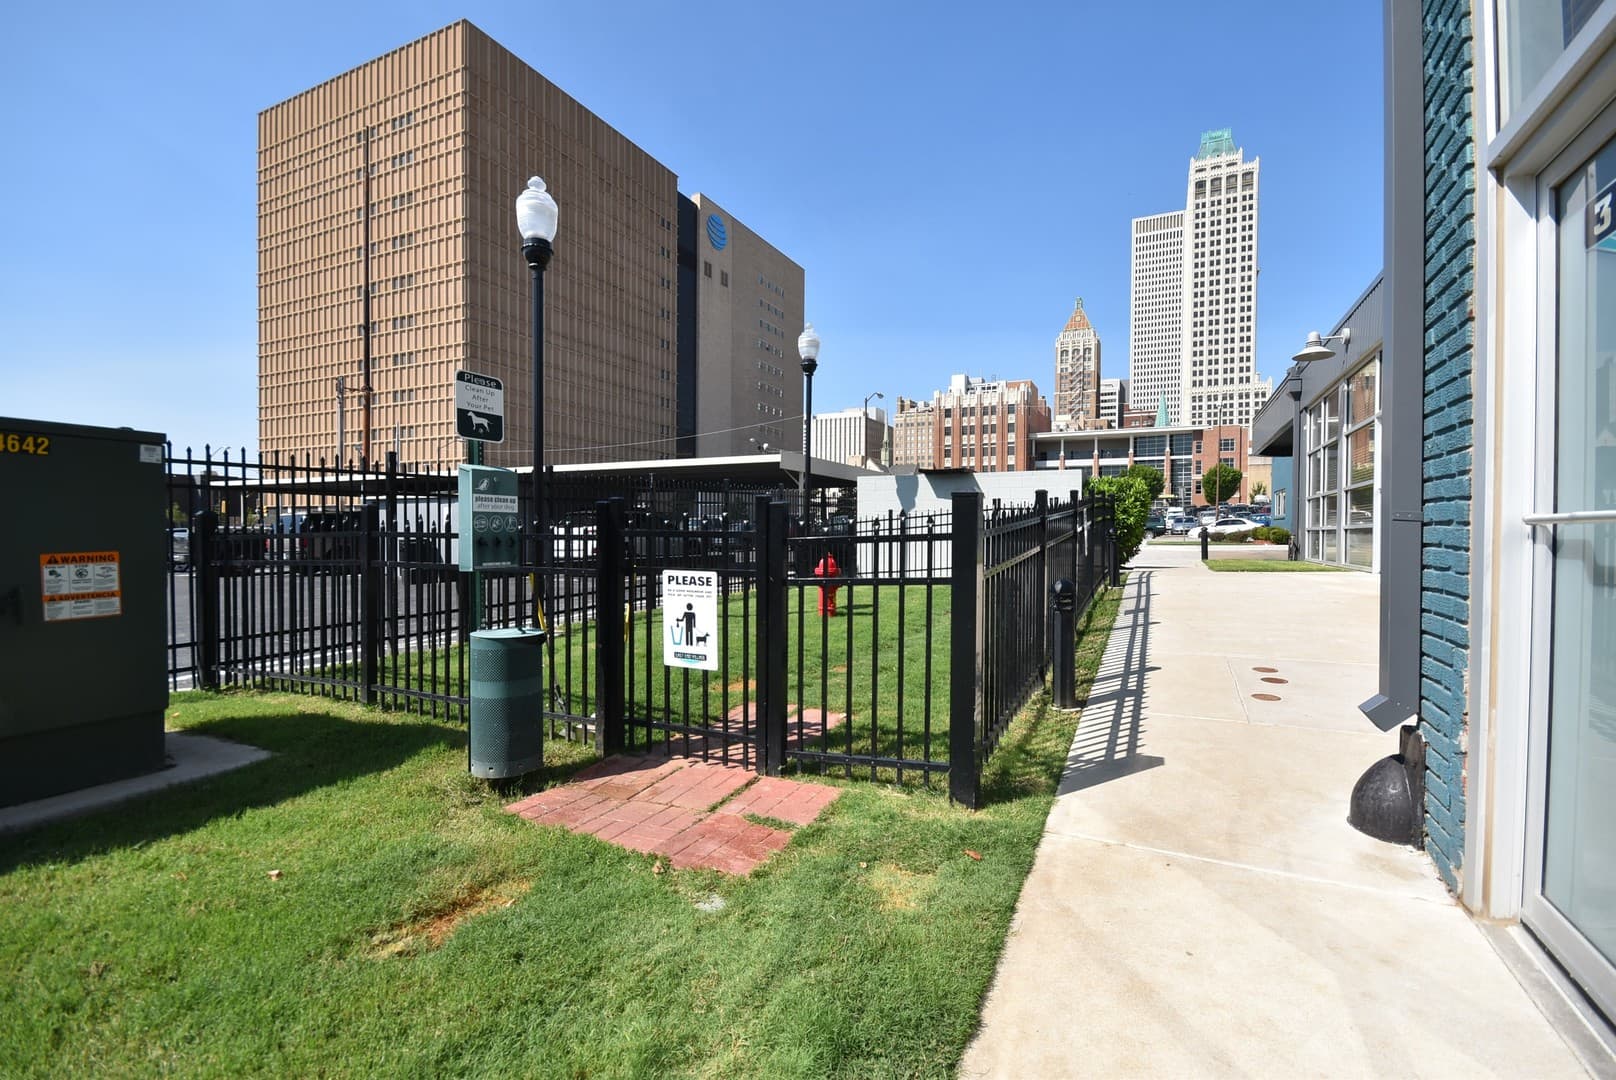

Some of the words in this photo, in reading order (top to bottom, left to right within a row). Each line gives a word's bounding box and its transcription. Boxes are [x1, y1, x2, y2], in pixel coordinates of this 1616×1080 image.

[464, 373, 497, 388] Please
[465, 385, 485, 394] Clean
[486, 389, 496, 397] Up
[472, 395, 489, 403] After
[466, 401, 482, 409] Your
[475, 495, 494, 503] please
[60, 553, 116, 564] WARNING
[667, 575, 713, 587] PLEASE
